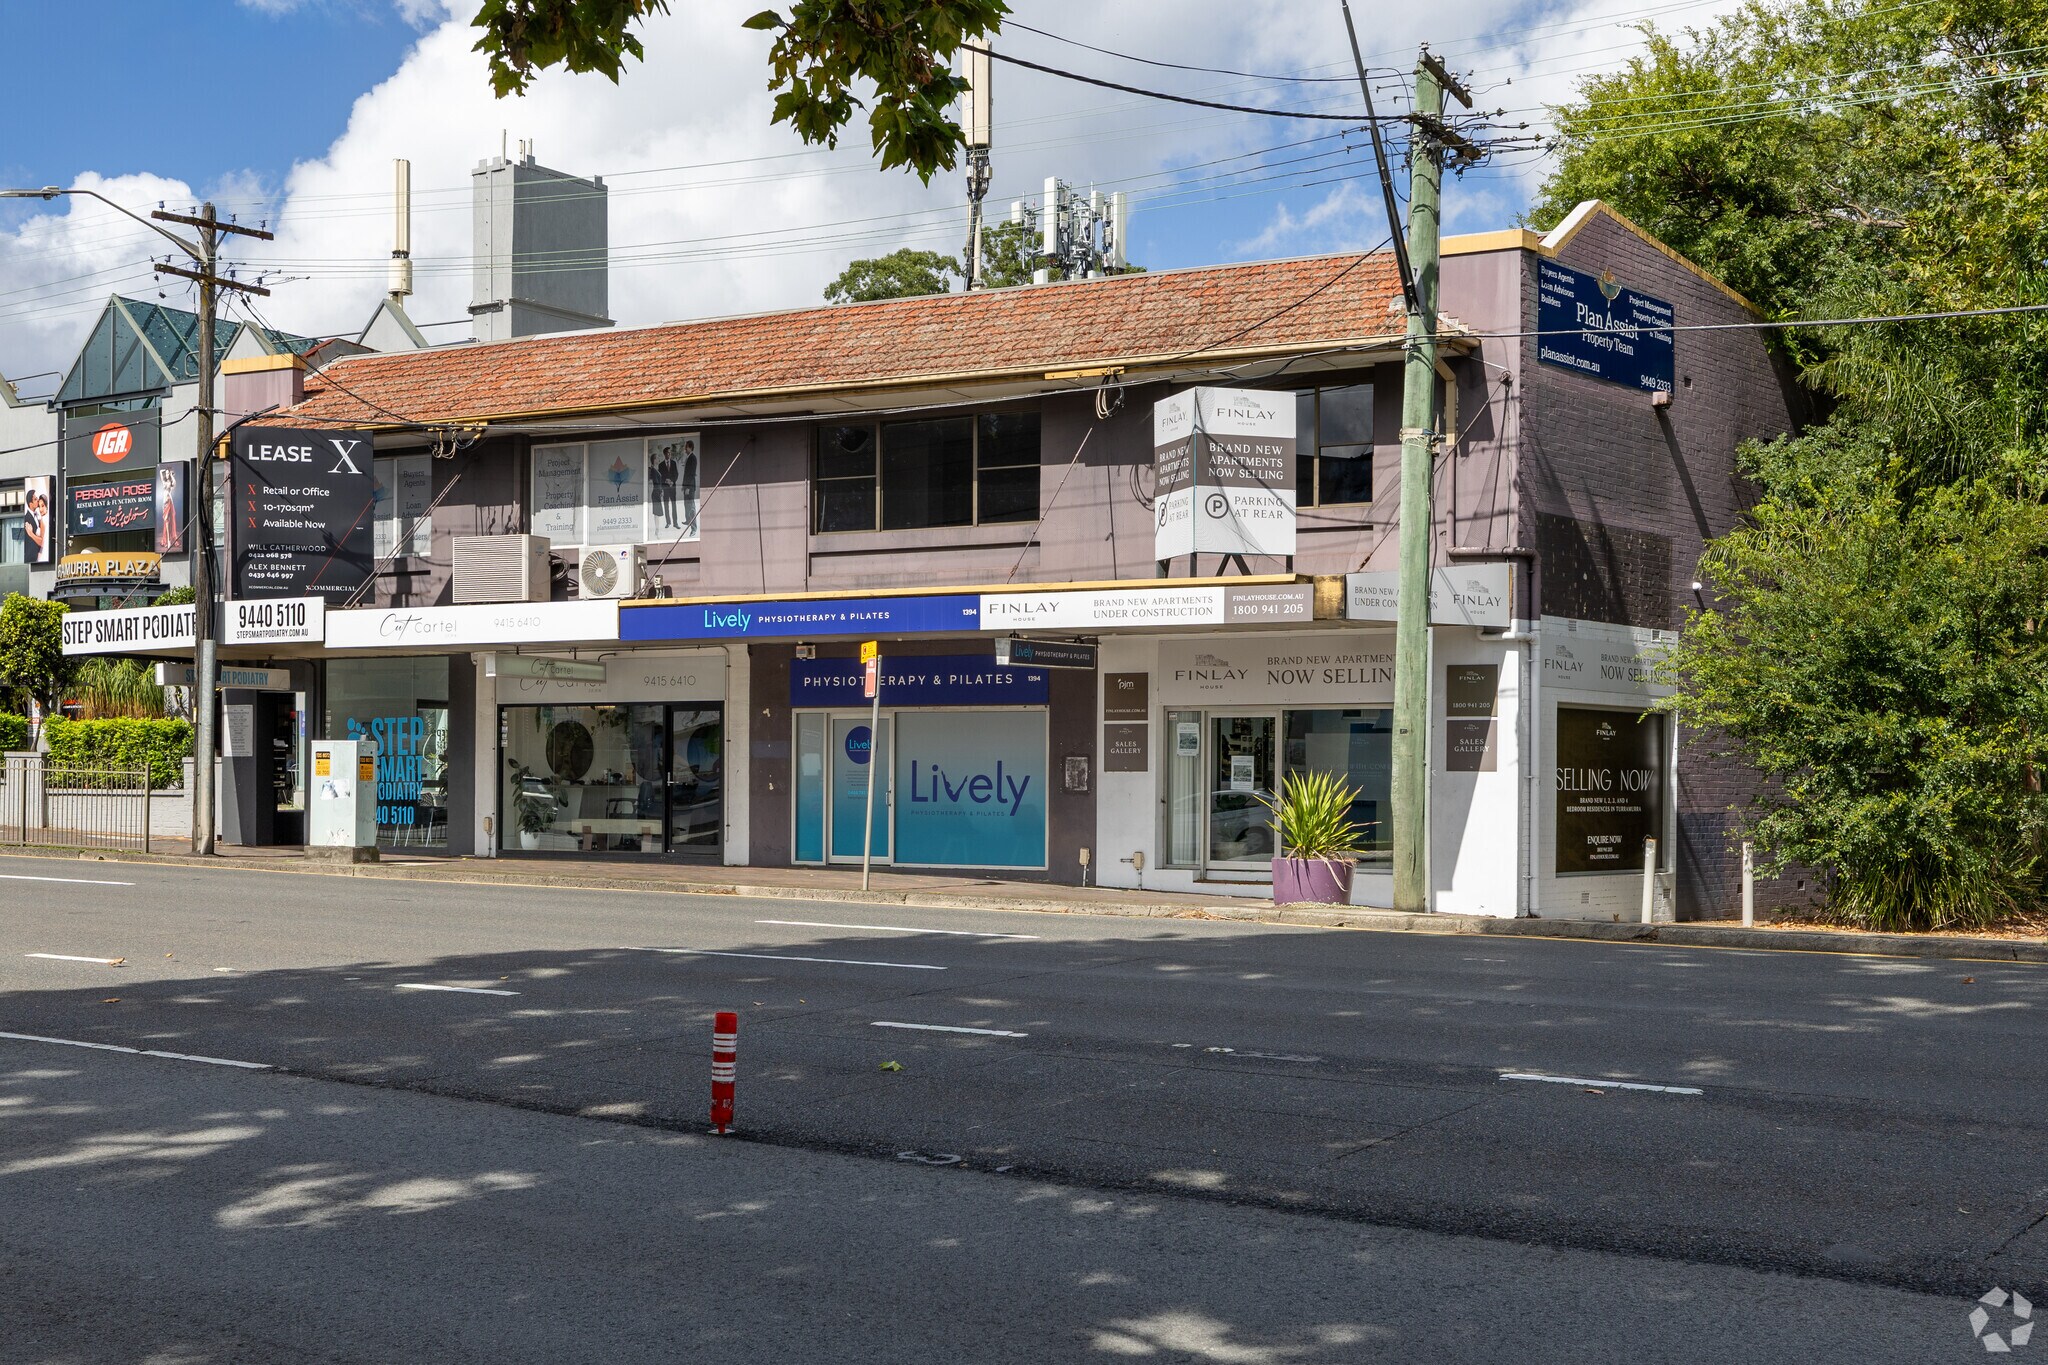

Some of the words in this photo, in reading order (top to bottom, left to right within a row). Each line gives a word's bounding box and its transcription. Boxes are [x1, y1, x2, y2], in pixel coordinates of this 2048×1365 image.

[1541, 266, 1558, 278] Buyers
[1558, 272, 1574, 284] Agents
[1541, 280, 1554, 291] Loan
[1554, 284, 1574, 298] Advisors
[1541, 294, 1561, 308] Builders
[1629, 295, 1644, 308] Project
[1644, 300, 1672, 316] Management
[1576, 302, 1603, 330] Plan
[1605, 311, 1639, 340] Assist
[1633, 310, 1652, 324] Property
[1652, 316, 1672, 329] Coaching
[1582, 328, 1613, 351] Property
[1614, 338, 1634, 356] Team
[1654, 331, 1672, 344] Training
[1541, 346, 1600, 372] planassist.com.au
[1640, 374, 1656, 388] 9449
[1656, 378, 1672, 392] 2333
[1162, 411, 1186, 428] FINLAY
[1218, 408, 1276, 420] FINLAY
[96, 429, 128, 455] IGA
[1209, 442, 1250, 454] BRAND
[1256, 445, 1283, 455] NEW
[248, 444, 312, 462] LEASE
[327, 439, 362, 474] X
[1160, 449, 1176, 462] BRAND
[1177, 444, 1190, 458] NEW
[548, 459, 570, 468] Project
[1160, 458, 1190, 474] APARTMENTS
[1208, 455, 1283, 468] APARTMENTS
[404, 470, 424, 478] Buyers
[538, 468, 581, 477] Management
[1160, 476, 1170, 486] NOW
[1170, 470, 1190, 484] SELLING
[1208, 467, 1236, 478] NOW
[1239, 469, 1284, 480] SELLING
[404, 480, 426, 488] Agents
[75, 487, 120, 501] PERSIAN
[123, 484, 152, 496] ROSE
[263, 486, 288, 496] Retail
[302, 488, 330, 496] Office
[546, 492, 574, 500] Property
[77, 500, 106, 509] RESTAURANT
[598, 496, 614, 504] Plan
[616, 494, 638, 502] Assist
[1168, 498, 1188, 510] PARKING
[1234, 496, 1284, 507] PARKING
[544, 502, 576, 510] Coaching
[1176, 510, 1188, 520] REAR
[1234, 510, 1248, 518] AT
[1254, 510, 1284, 519] REAR
[263, 520, 302, 528] Available
[305, 520, 326, 529] Now
[546, 522, 574, 532] Training
[270, 544, 326, 552] CATHERWOOD
[106, 560, 158, 576] PLAZA
[1354, 586, 1378, 594] BRAND
[1379, 587, 1394, 595] NEW
[1094, 599, 1124, 607] BRAND
[1152, 596, 1213, 605] APARTMENTS
[1354, 598, 1380, 606] UNDER
[1453, 594, 1502, 607] FINLAY
[990, 602, 1060, 614] FINLAY
[1094, 610, 1128, 618] UNDER
[1132, 607, 1213, 617] CONSTRUCTION
[1234, 605, 1258, 614] 1800
[1262, 604, 1278, 614] 941
[1284, 604, 1304, 614] 205
[239, 604, 272, 628] 9440
[277, 602, 305, 626] 5110
[704, 608, 751, 631] Lively
[758, 614, 836, 623] PHYSIOTHERAPY
[850, 612, 890, 620] PILATES
[64, 620, 92, 645] STEP
[96, 617, 140, 643] SMART
[380, 613, 422, 640] Cut
[414, 620, 456, 634] Cartel
[494, 618, 514, 628] 9415
[518, 616, 540, 628] 6410
[1015, 644, 1034, 660] Lively
[1035, 650, 1068, 659] PHYSIOTHERAPY
[1601, 654, 1619, 662] BRAND
[1267, 656, 1302, 665] BRAND
[1306, 656, 1331, 664] NEW
[1544, 659, 1584, 672] FINLAY
[232, 670, 268, 686] PODIATRY
[1176, 669, 1248, 680] FINLAY
[1267, 669, 1314, 684] NOW
[1323, 668, 1396, 684] SELLIN
[1600, 665, 1624, 680] NOW
[644, 676, 667, 687] 9415
[670, 675, 696, 686] 6410
[804, 675, 926, 686] PHYSIOTERAPY
[934, 675, 941, 685] &
[950, 674, 1014, 684] PILATES
[1118, 679, 1134, 690] pjm
[372, 716, 424, 756] STEP
[1556, 768, 1612, 791] SELLING
[1620, 770, 1654, 791] NOW
[377, 782, 423, 800] ODIATRY
[912, 760, 1030, 816] Lively
[392, 806, 414, 824] 5110
[1588, 836, 1608, 845] ENQUIRE
